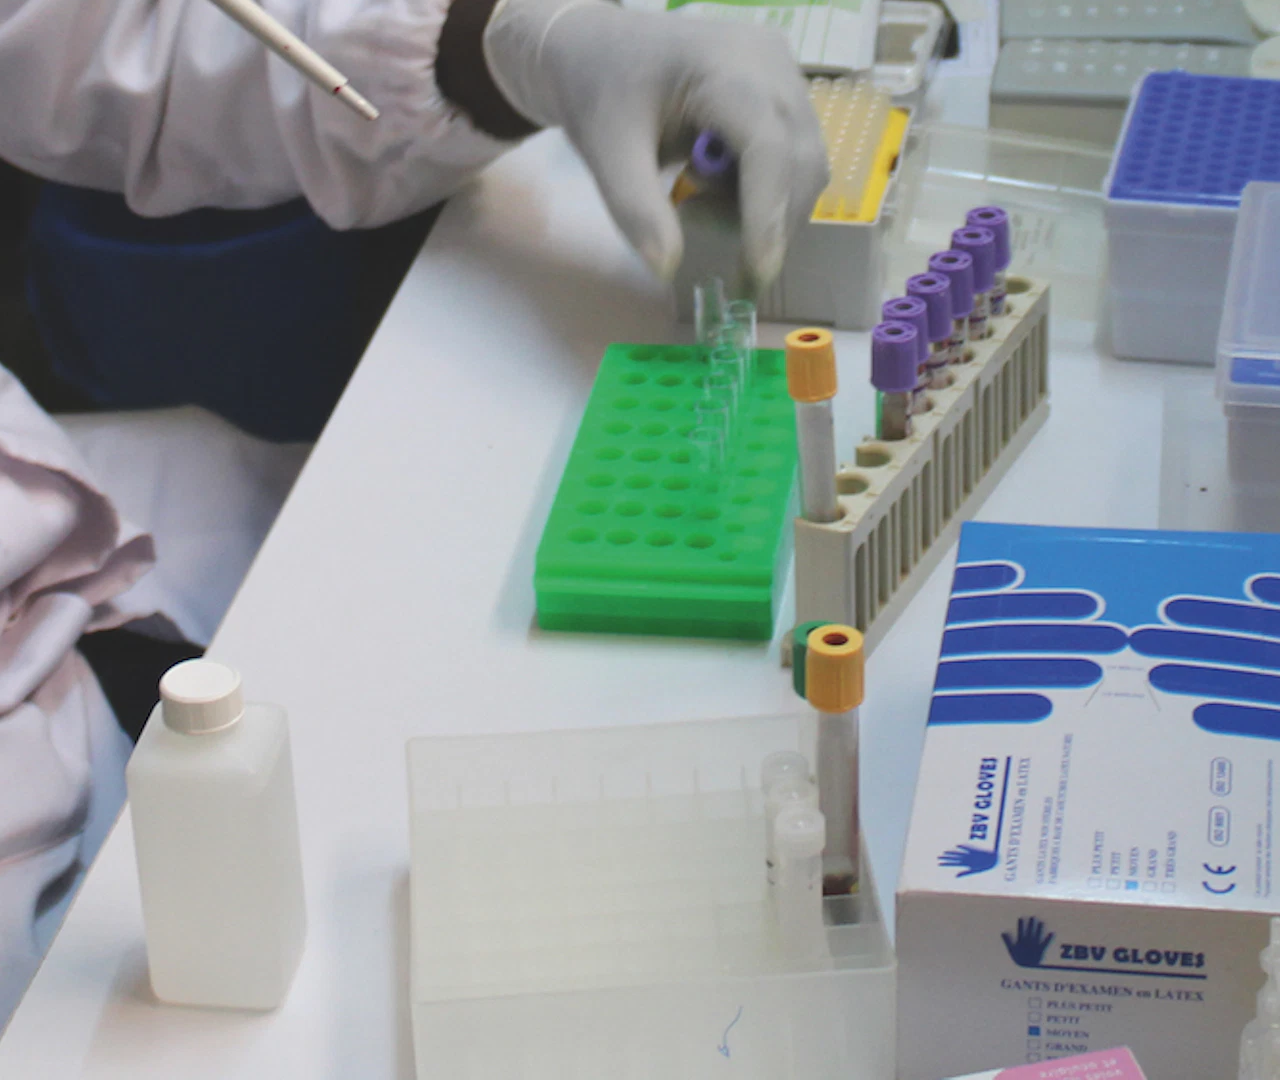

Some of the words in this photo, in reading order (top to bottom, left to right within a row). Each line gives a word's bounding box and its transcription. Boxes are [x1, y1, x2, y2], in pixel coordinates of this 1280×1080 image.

[974, 757, 998, 809] GLOVES
[1016, 758, 1031, 786] LATEX
[969, 813, 989, 840] ZBV
[1008, 799, 1025, 846] D'EXAMEN
[1004, 847, 1019, 882] GANTS
[1202, 862, 1237, 894] CE
[1060, 943, 1106, 961] ZBV
[1112, 947, 1206, 968] GLOVES
[1000, 978, 1051, 992] GANTS
[1054, 981, 1133, 997] D'EXAMEN
[1136, 990, 1151, 998] en
[1154, 989, 1204, 1002] LATEX
[1046, 1000, 1077, 1010] PLUS
[1078, 1002, 1113, 1013] PETIT
[1046, 1015, 1080, 1025] PETIT
[1046, 1028, 1090, 1039] MOYEN
[1045, 1042, 1088, 1052] GRAND
